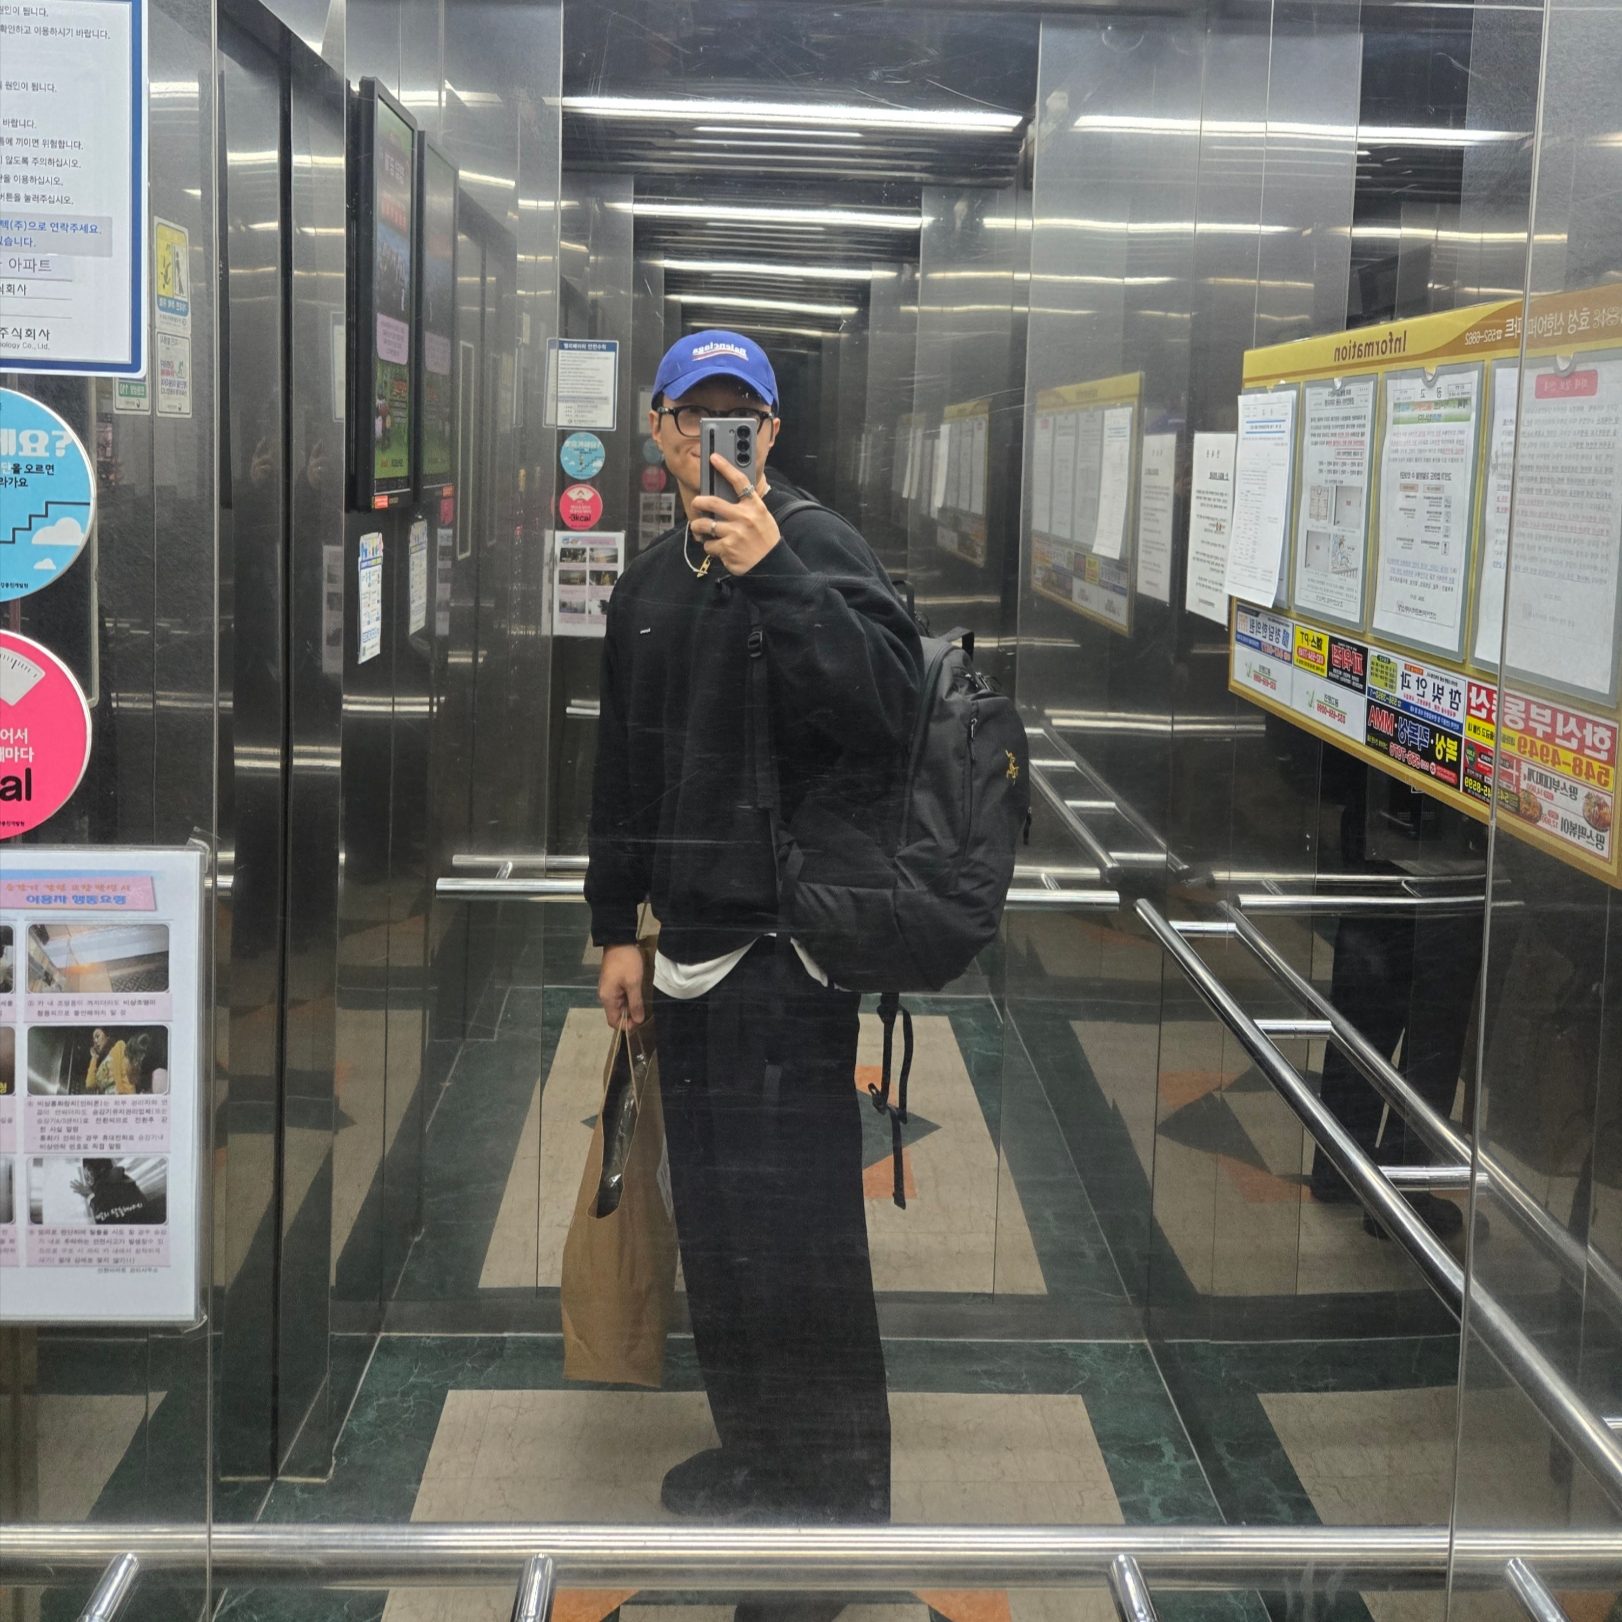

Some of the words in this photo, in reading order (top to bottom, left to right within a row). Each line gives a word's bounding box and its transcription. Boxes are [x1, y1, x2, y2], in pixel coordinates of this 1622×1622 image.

[23, 6, 49, 17] 됩니다.
[34, 26, 73, 38] 이용하시기
[75, 29, 110, 40] 바랍니다.
[4, 81, 29, 92] 원인이
[31, 82, 57, 93] 됩니다.
[2, 118, 37, 129] 바랍니다.
[16, 137, 39, 148] 끼이면
[42, 138, 84, 150] 위험합니다.
[5, 155, 29, 167] 않도록
[31, 156, 81, 169] 주의하십시오.
[13, 174, 64, 186] 이용하십시오.
[24, 193, 74, 206] 눌러주십시오.
[50, 222, 102, 234] 연락주세요.
[8, 257, 52, 272] 아파트
[24, 462, 55, 475] 오르면
[569, 514, 591, 522] -3kcal
